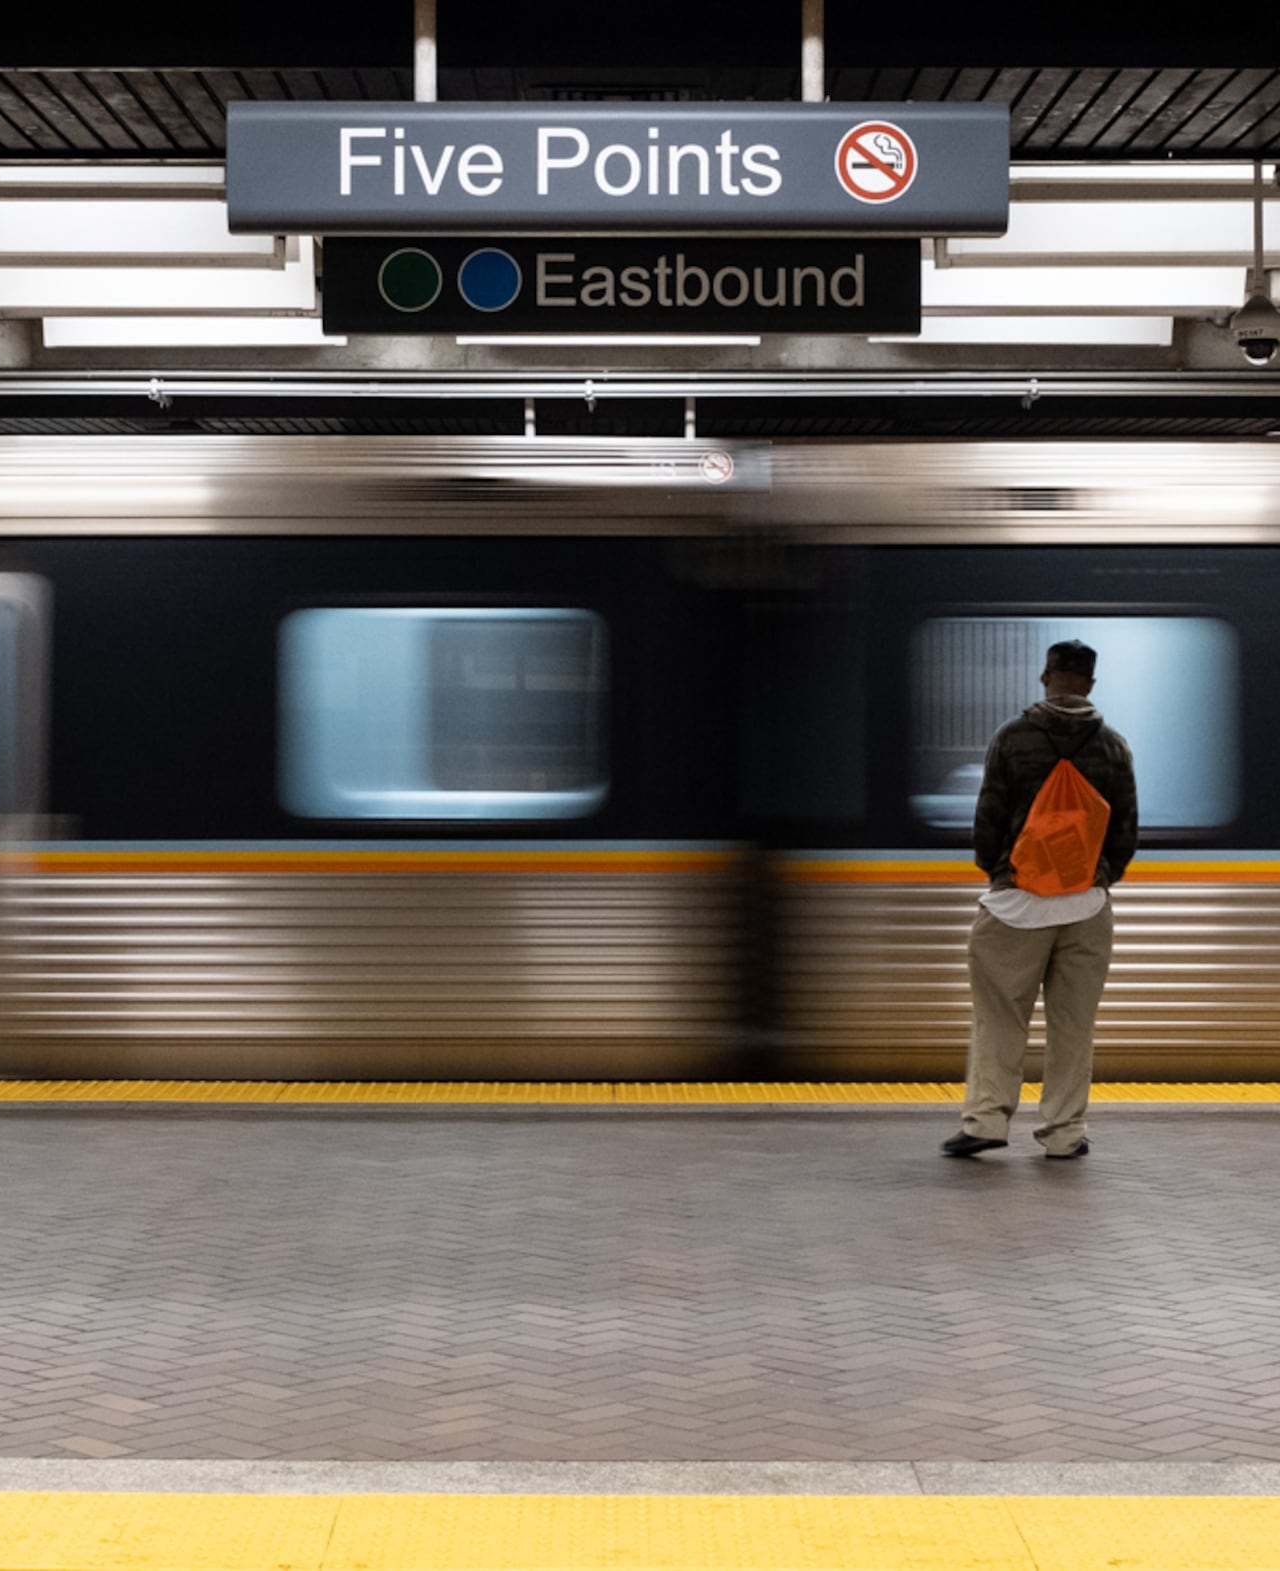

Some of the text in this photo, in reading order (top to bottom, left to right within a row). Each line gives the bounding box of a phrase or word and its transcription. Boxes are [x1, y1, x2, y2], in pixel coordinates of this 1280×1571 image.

[339, 127, 783, 197] Five Points
[535, 252, 866, 308] Eastbound
